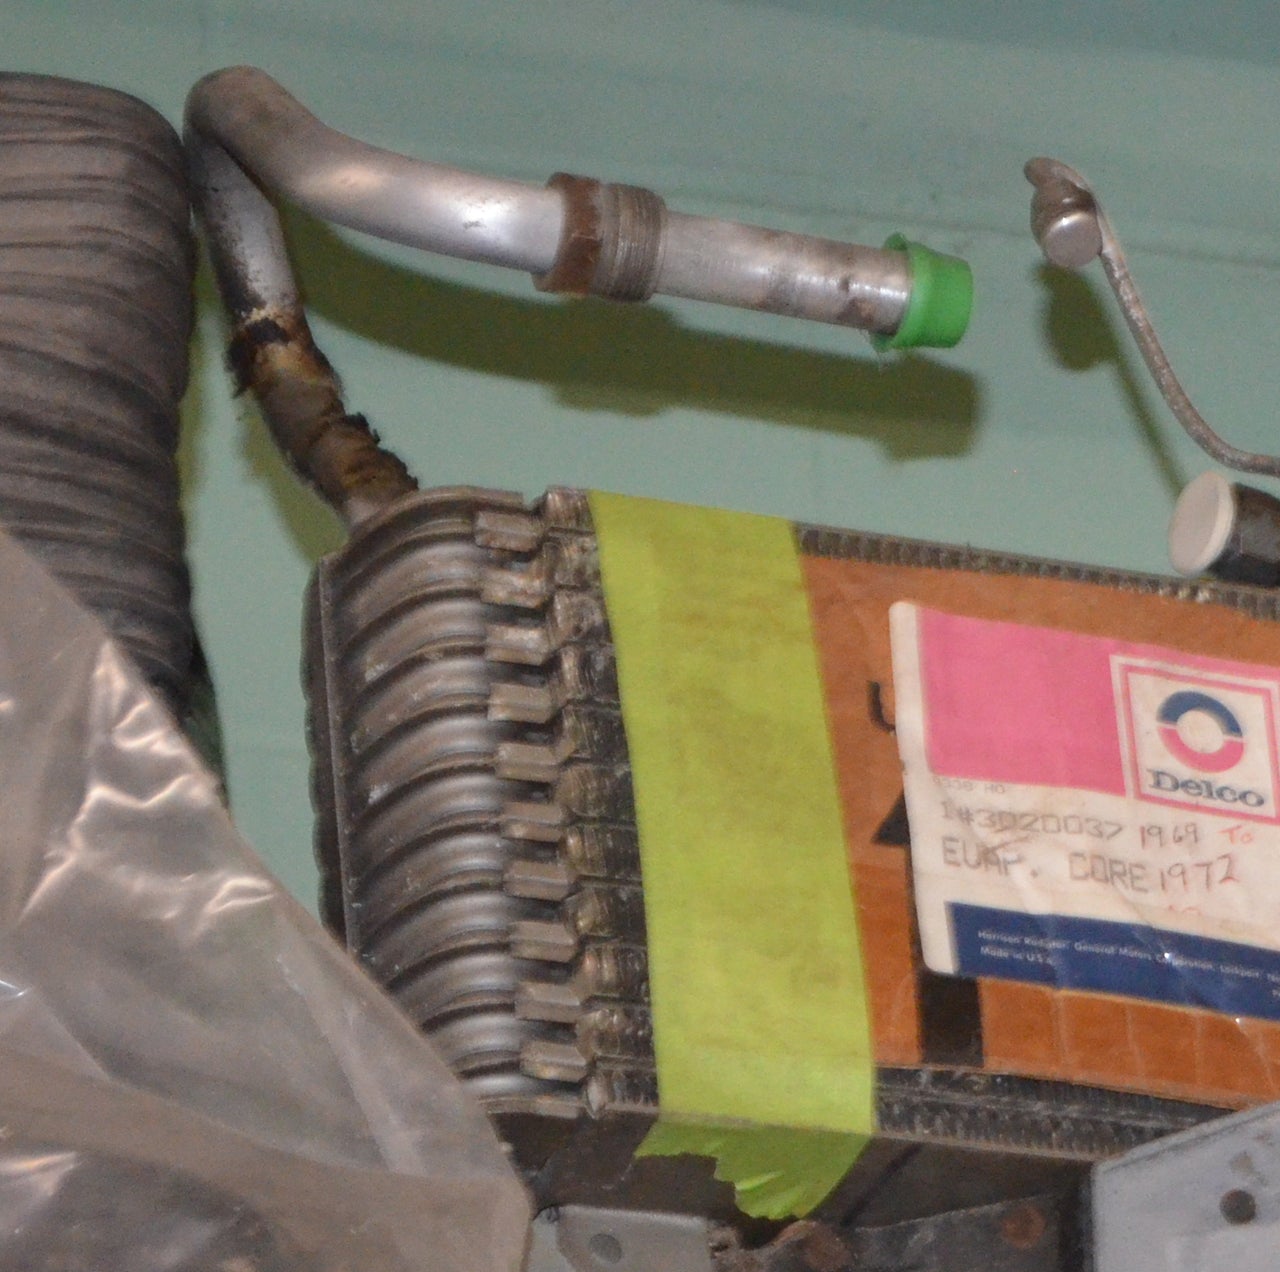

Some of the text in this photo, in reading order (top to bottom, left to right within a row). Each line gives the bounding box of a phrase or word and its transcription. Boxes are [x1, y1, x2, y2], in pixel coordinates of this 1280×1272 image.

[1147, 769, 1265, 808] Delco
[1139, 822, 1199, 848] 1969
[1069, 852, 1149, 892] CORE
[1159, 854, 1240, 892] 1972
